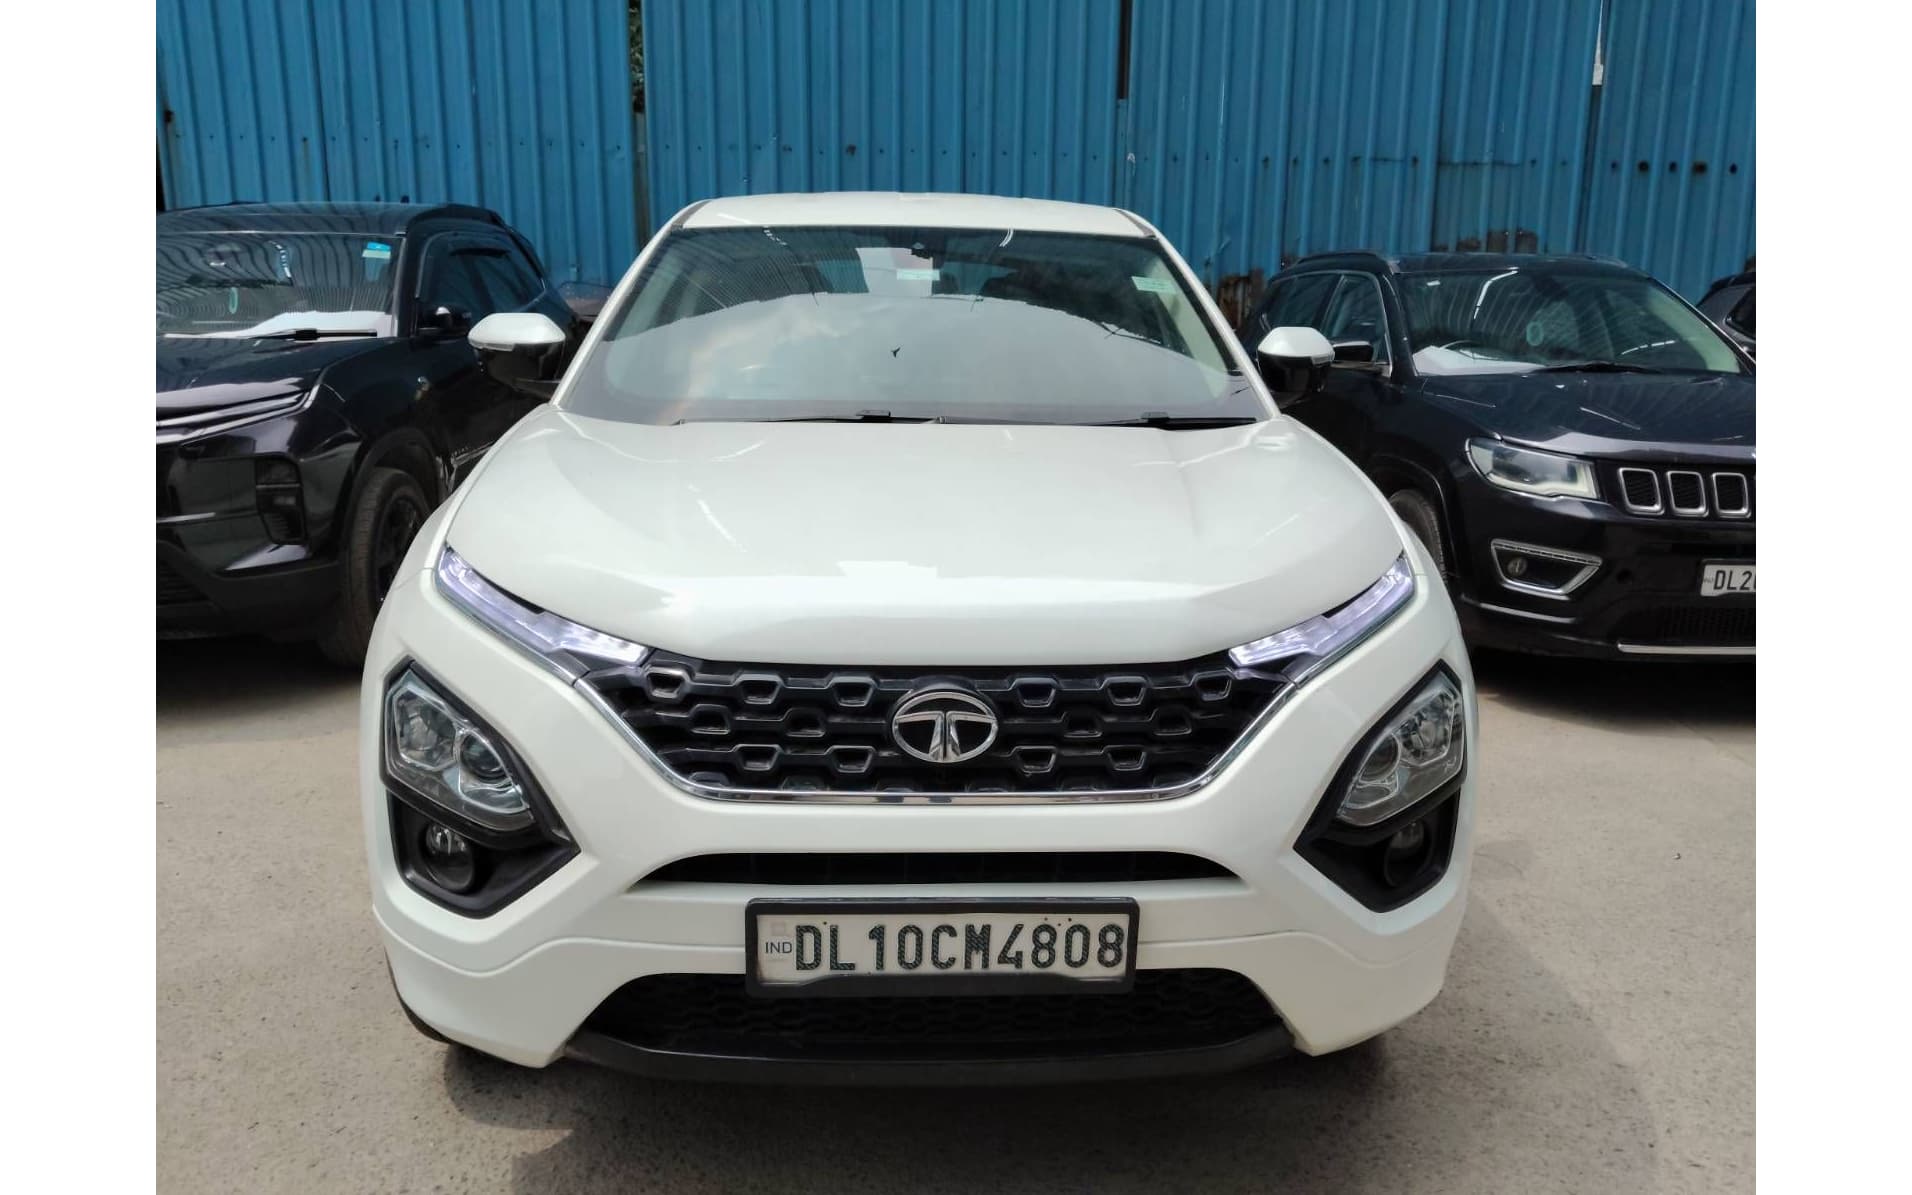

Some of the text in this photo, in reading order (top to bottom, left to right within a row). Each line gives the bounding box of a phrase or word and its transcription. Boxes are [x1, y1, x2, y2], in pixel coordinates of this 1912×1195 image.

[1713, 569, 1756, 591] DL2
[765, 941, 793, 954] IND
[795, 923, 1125, 972] DL10CM4808
